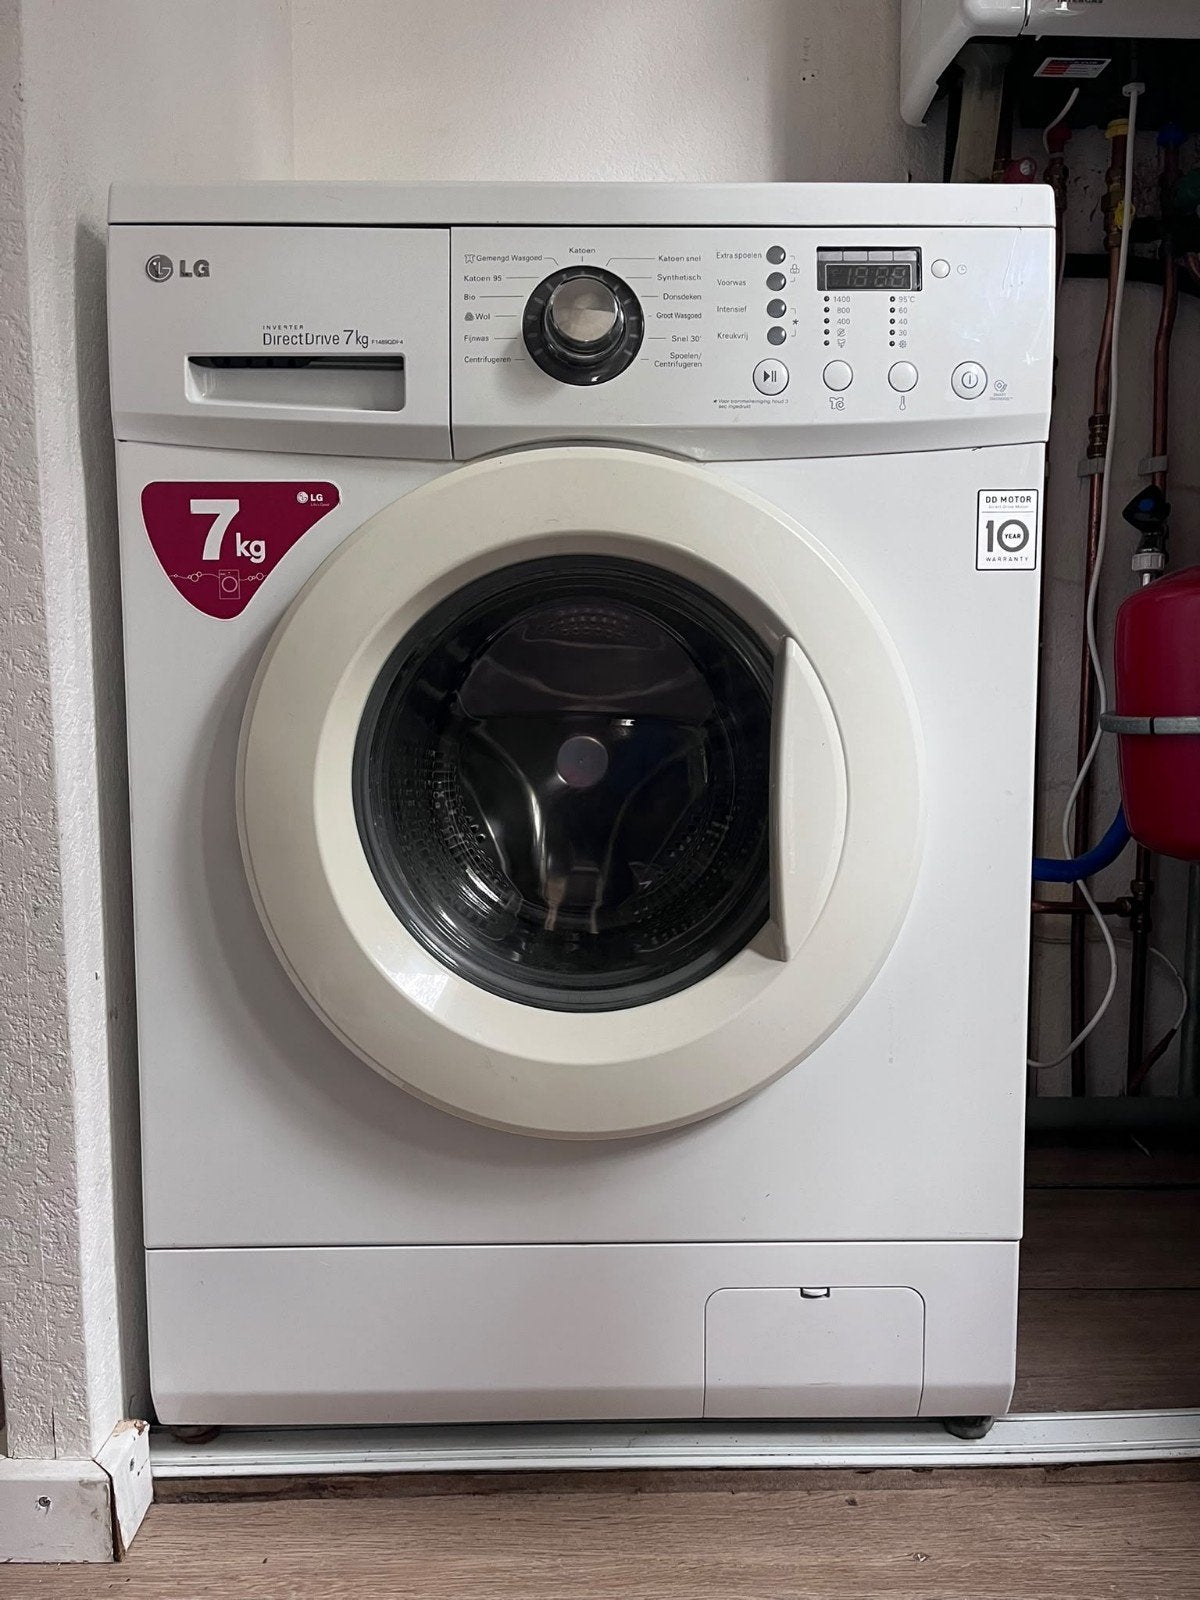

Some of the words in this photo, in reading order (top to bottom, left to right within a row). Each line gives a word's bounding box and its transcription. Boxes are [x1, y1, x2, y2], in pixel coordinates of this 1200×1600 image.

[476, 254, 510, 262] Gemengd
[734, 252, 762, 260] spoelen
[179, 259, 211, 278] LG
[833, 295, 851, 303] 1400
[716, 305, 747, 313] Intensief
[674, 312, 702, 320] Wasgoed
[836, 317, 851, 325] 400
[463, 334, 490, 343] Fijnwas
[671, 334, 689, 342] Snel
[717, 331, 749, 340] Kreukvrij
[464, 355, 512, 364] Centrifugeren
[669, 351, 702, 360] Spoelen/
[654, 360, 702, 369] Centrifugeren
[310, 493, 323, 501] LG
[985, 496, 998, 504] DD
[1000, 495, 1032, 504] MOTOR
[986, 519, 1030, 552] 10
